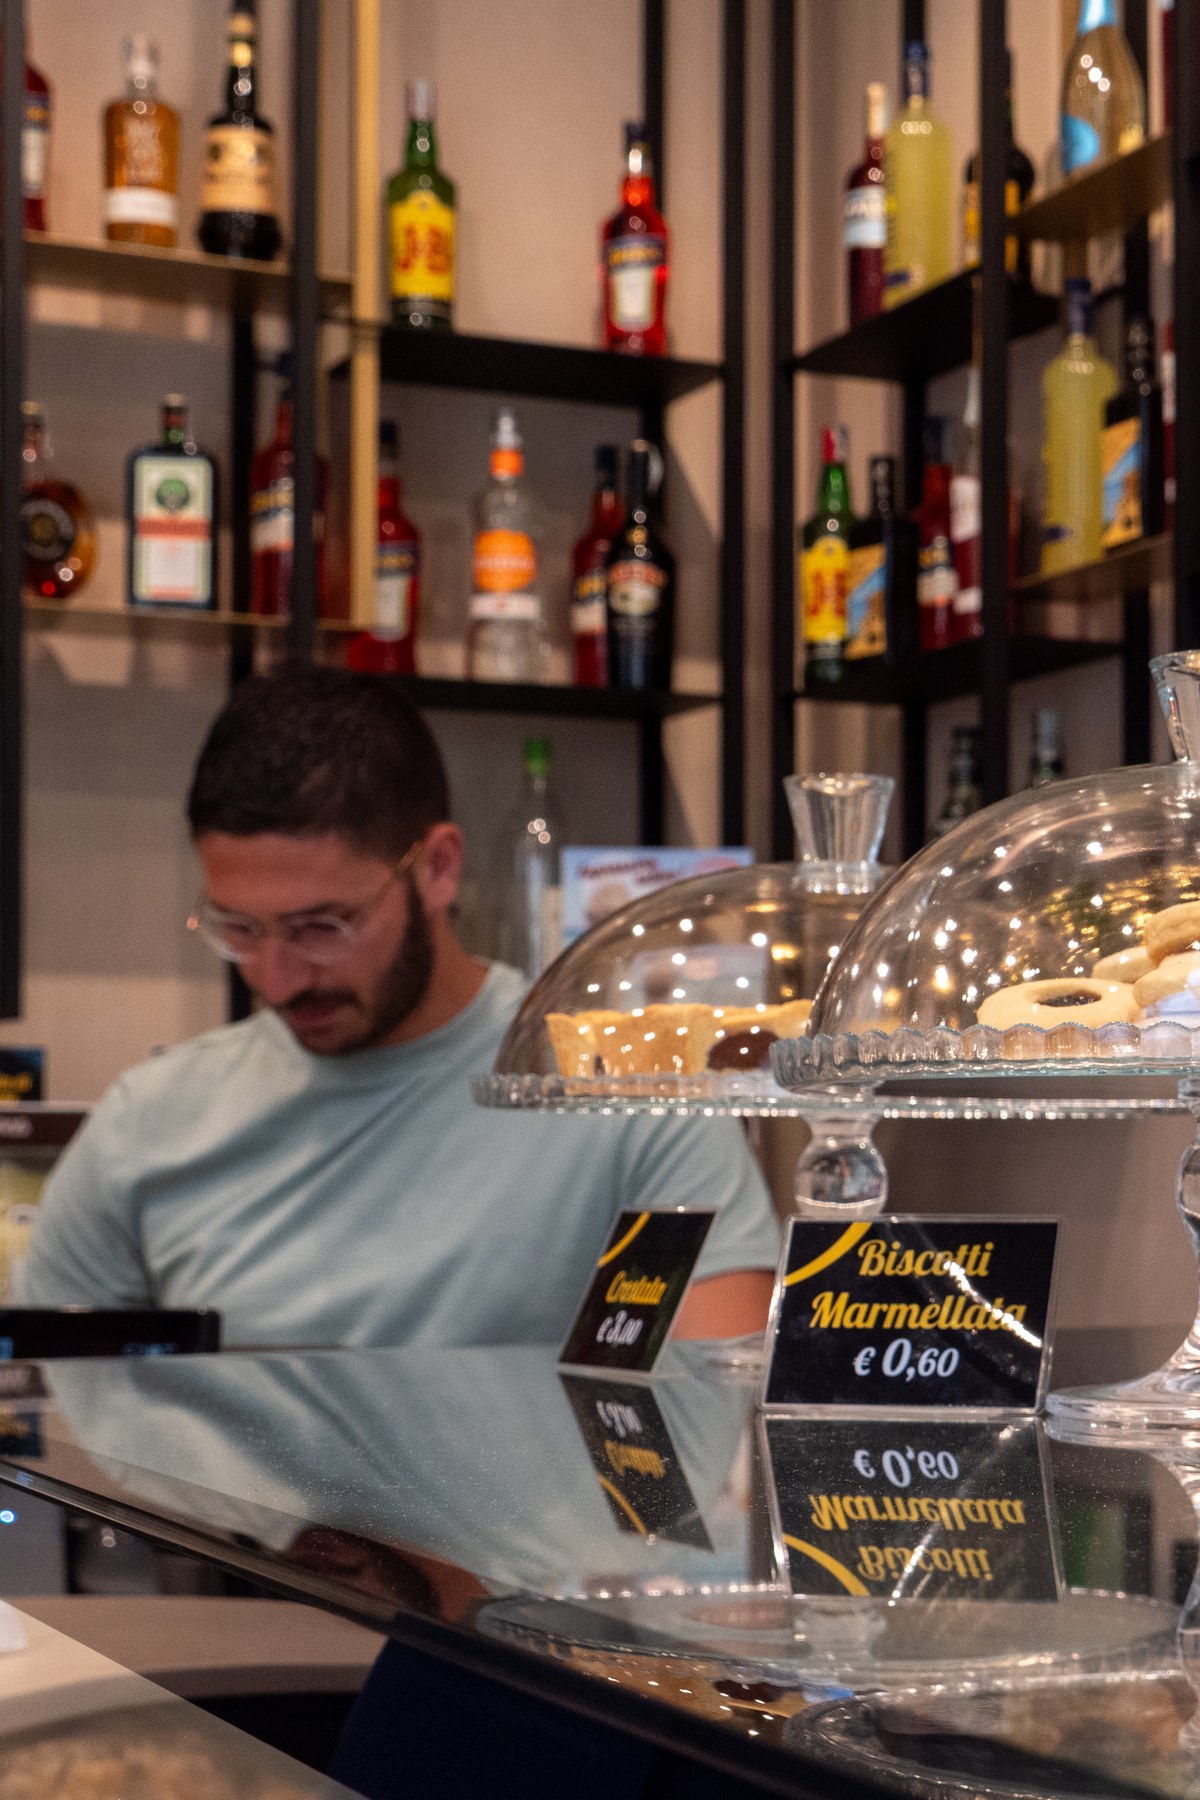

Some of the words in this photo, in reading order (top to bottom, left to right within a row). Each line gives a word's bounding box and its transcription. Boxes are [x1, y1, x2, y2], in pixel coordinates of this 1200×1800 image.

[857, 1239, 994, 1277] Biscotti
[810, 1292, 1025, 1330] Marmellata
[854, 1347, 876, 1375] €
[883, 1339, 959, 1381] 0,60
